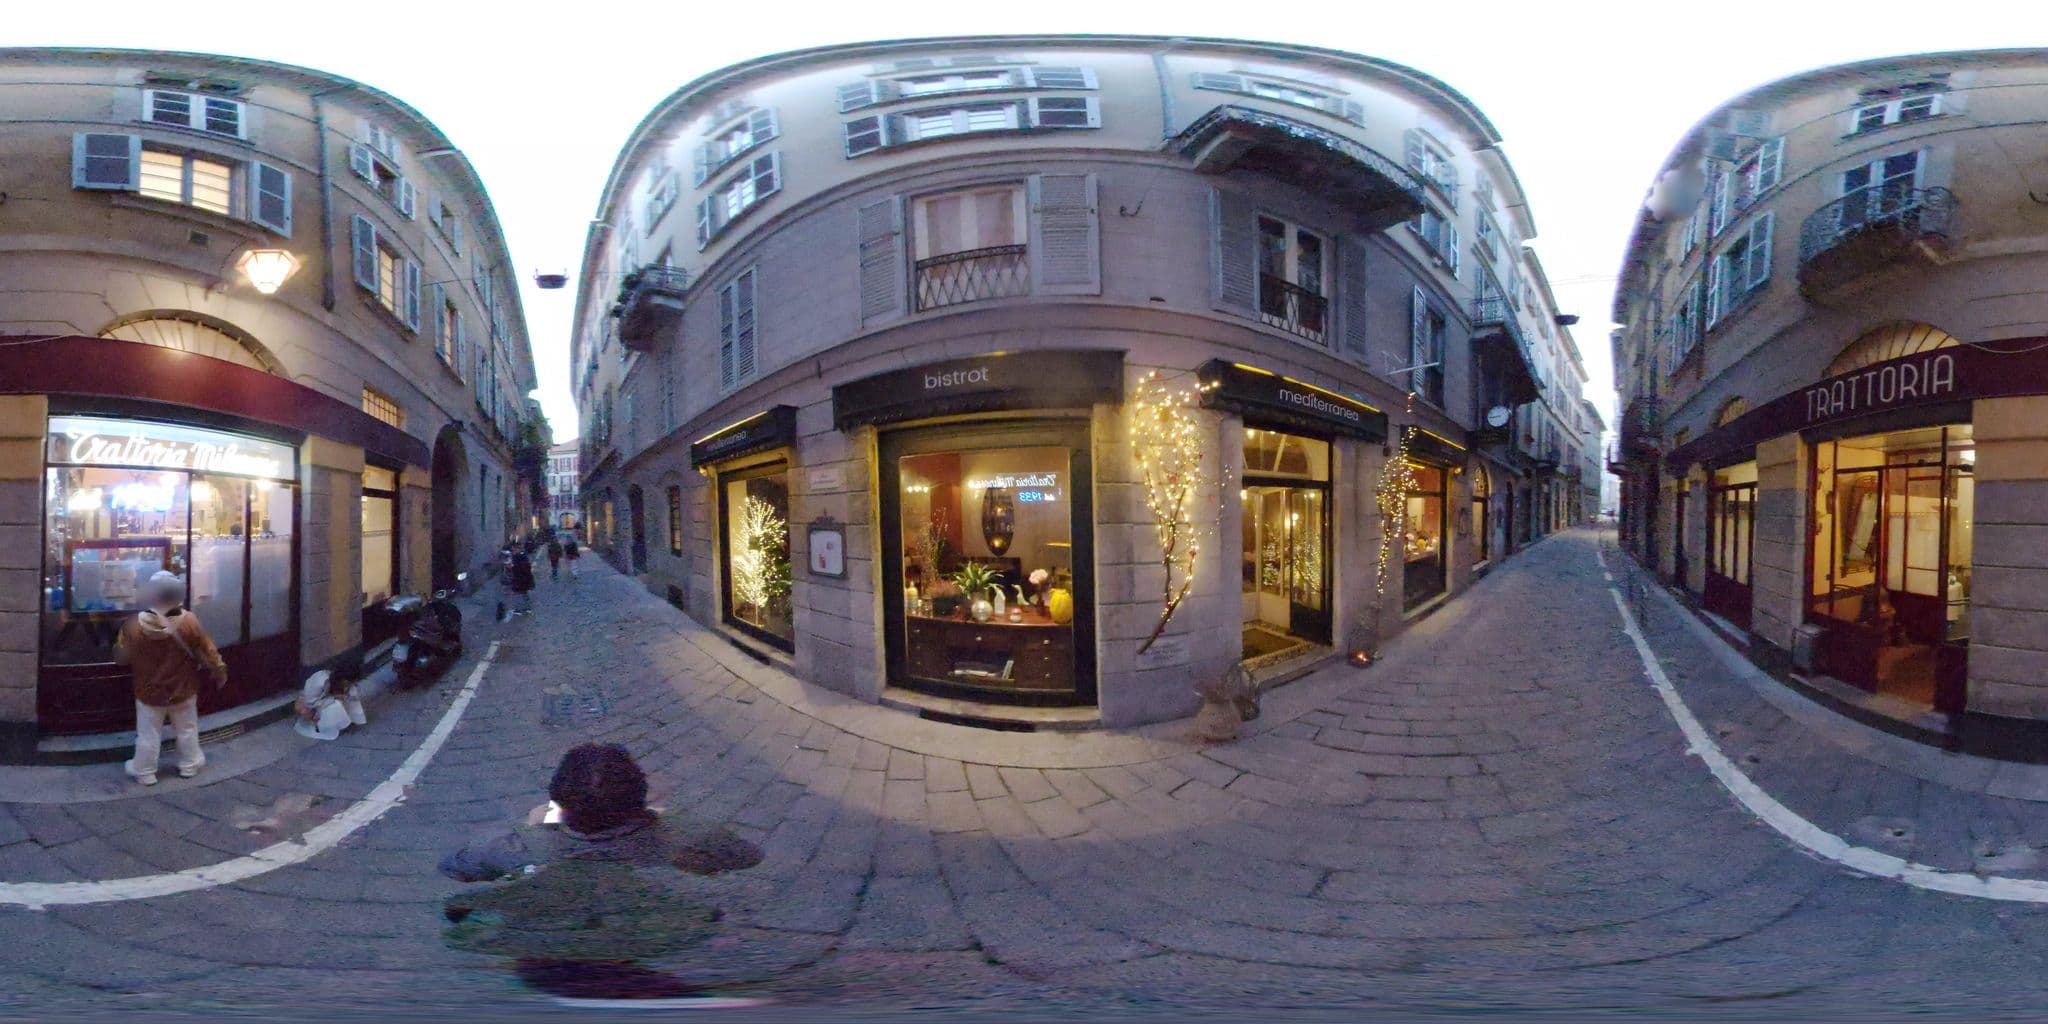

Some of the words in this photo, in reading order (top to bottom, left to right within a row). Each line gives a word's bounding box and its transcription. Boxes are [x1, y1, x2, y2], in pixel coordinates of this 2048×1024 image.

[924, 367, 989, 389] bistrot
[1805, 354, 1954, 422] TRATTORIA
[1279, 388, 1359, 421] mediterranea
